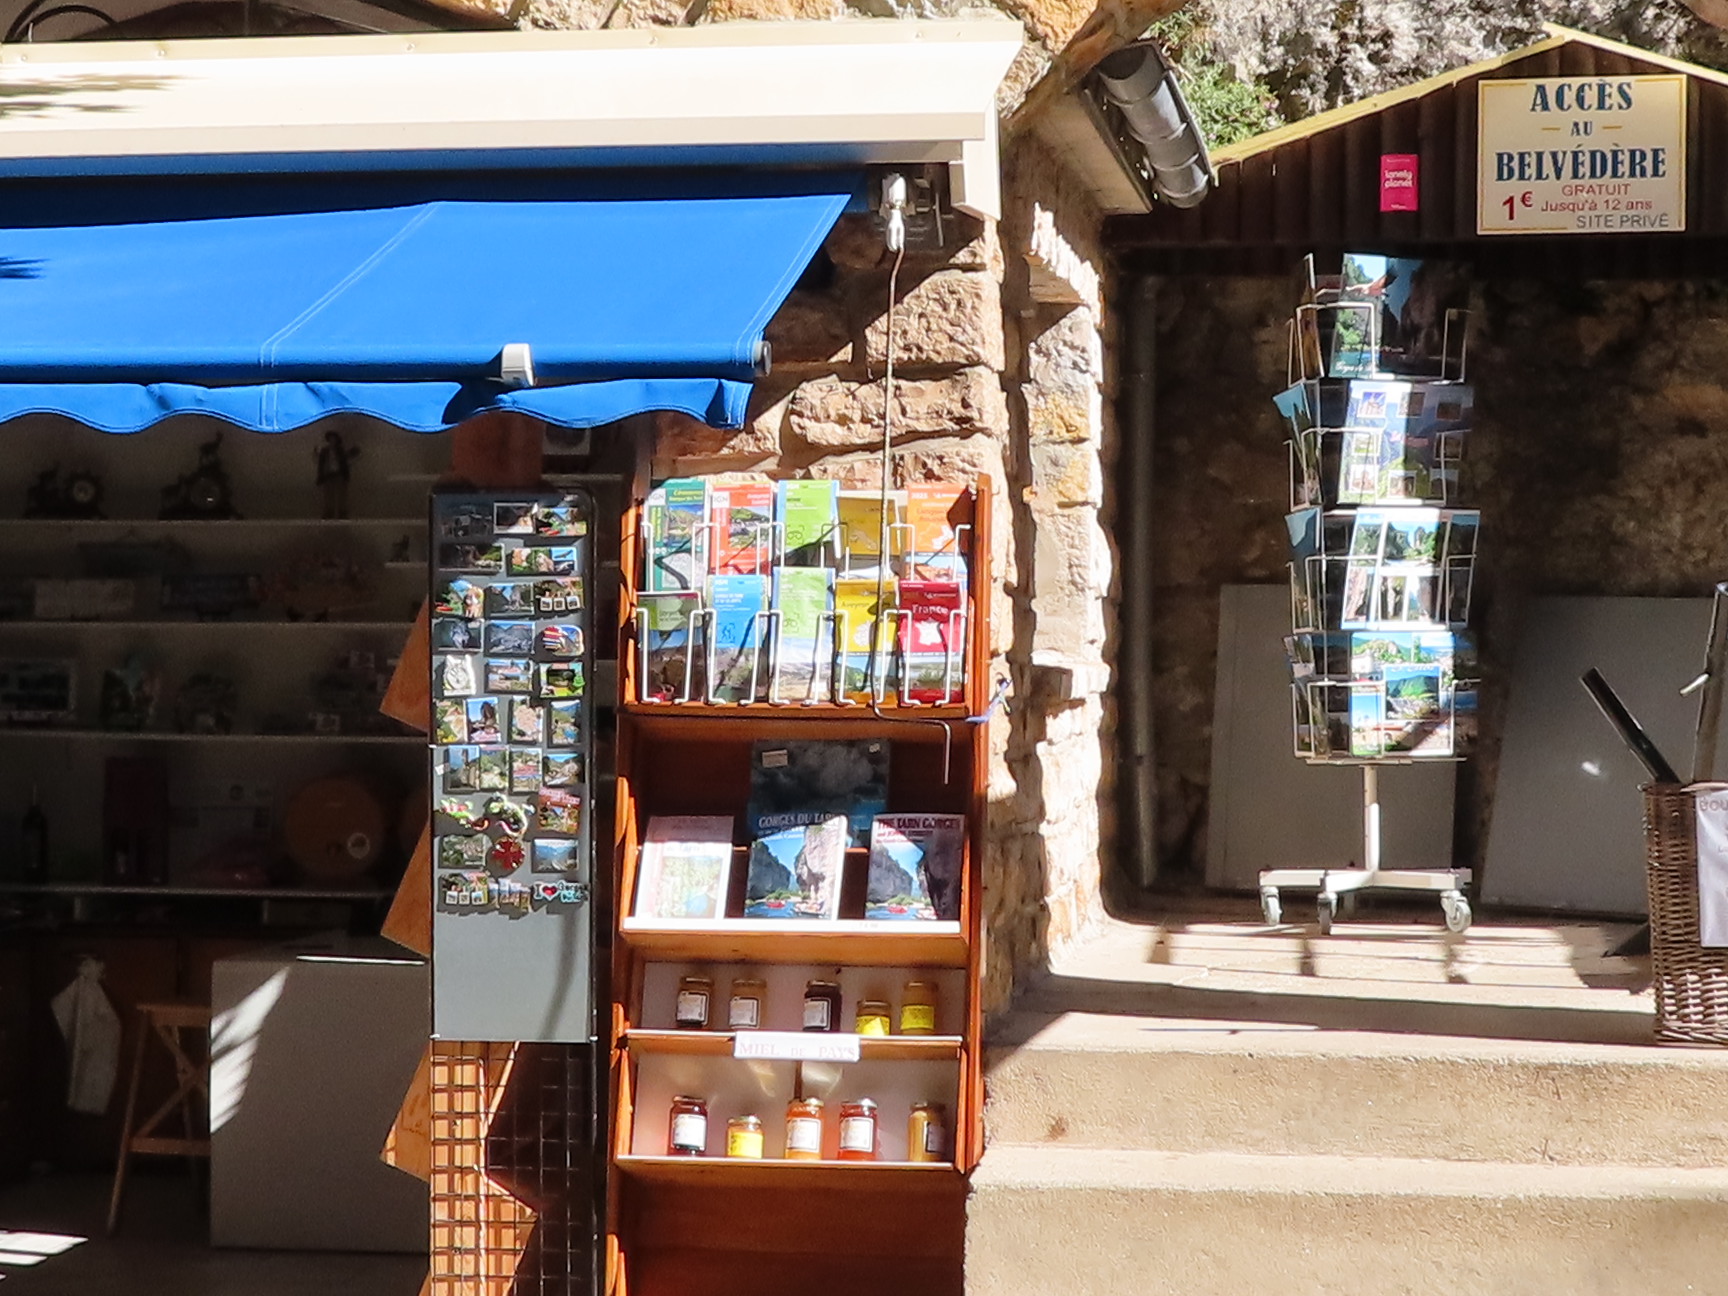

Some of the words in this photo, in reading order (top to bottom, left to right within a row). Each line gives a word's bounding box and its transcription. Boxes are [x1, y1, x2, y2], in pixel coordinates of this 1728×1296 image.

[1530, 79, 1633, 112] ACCÈS
[1570, 121, 1593, 136] AU
[1494, 143, 1667, 182] BELVÉDÈRE
[1561, 183, 1631, 196] GRATUIT
[1541, 199, 1598, 214] Jusqu'à
[1603, 199, 1621, 211] 12
[1625, 200, 1653, 211] ans
[1576, 214, 1614, 229] SITE
[1619, 212, 1669, 228] PRIVÉ
[912, 604, 949, 614] France
[797, 813, 812, 825] DU
[739, 1043, 780, 1056] MIEL
[791, 1047, 807, 1057] DE
